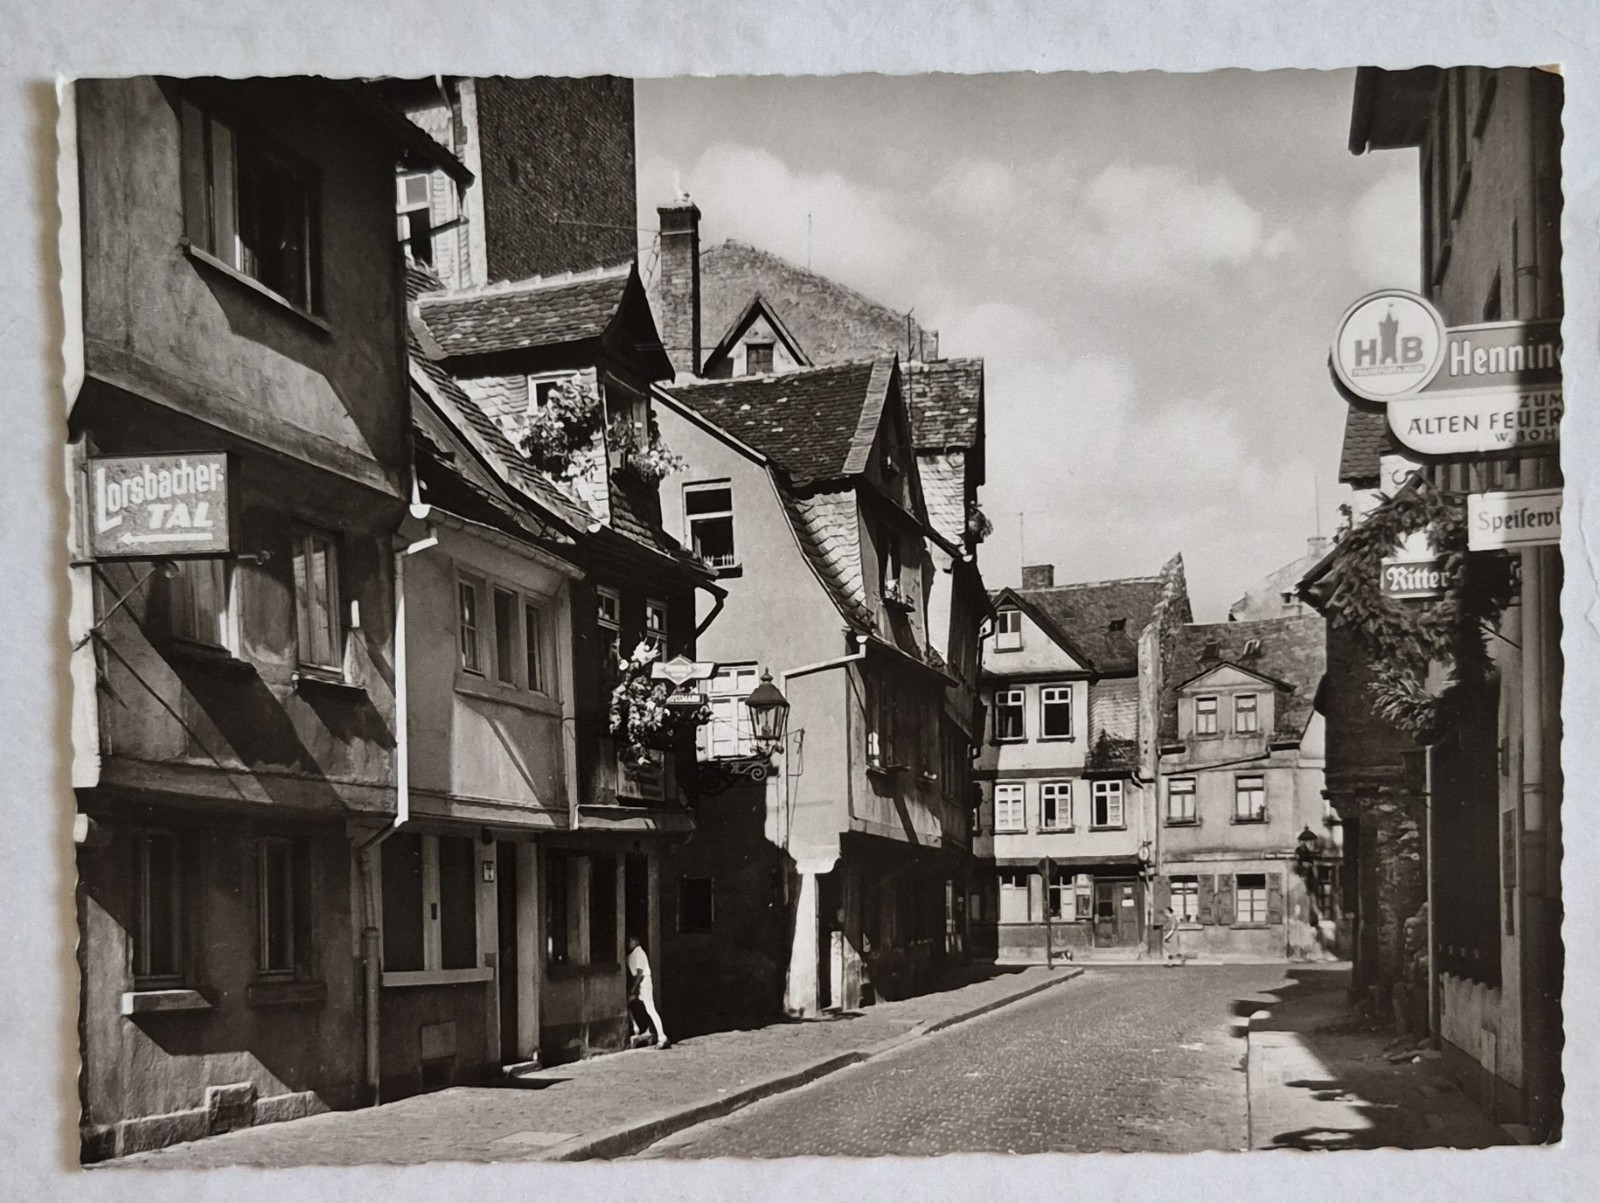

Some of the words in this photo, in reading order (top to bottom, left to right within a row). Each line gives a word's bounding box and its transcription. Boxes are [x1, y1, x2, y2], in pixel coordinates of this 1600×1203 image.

[1407, 414, 1478, 435] ALTEN
[1490, 408, 1562, 430] FEUER
[147, 502, 214, 530] TAL
[1386, 566, 1451, 592] Ritter
